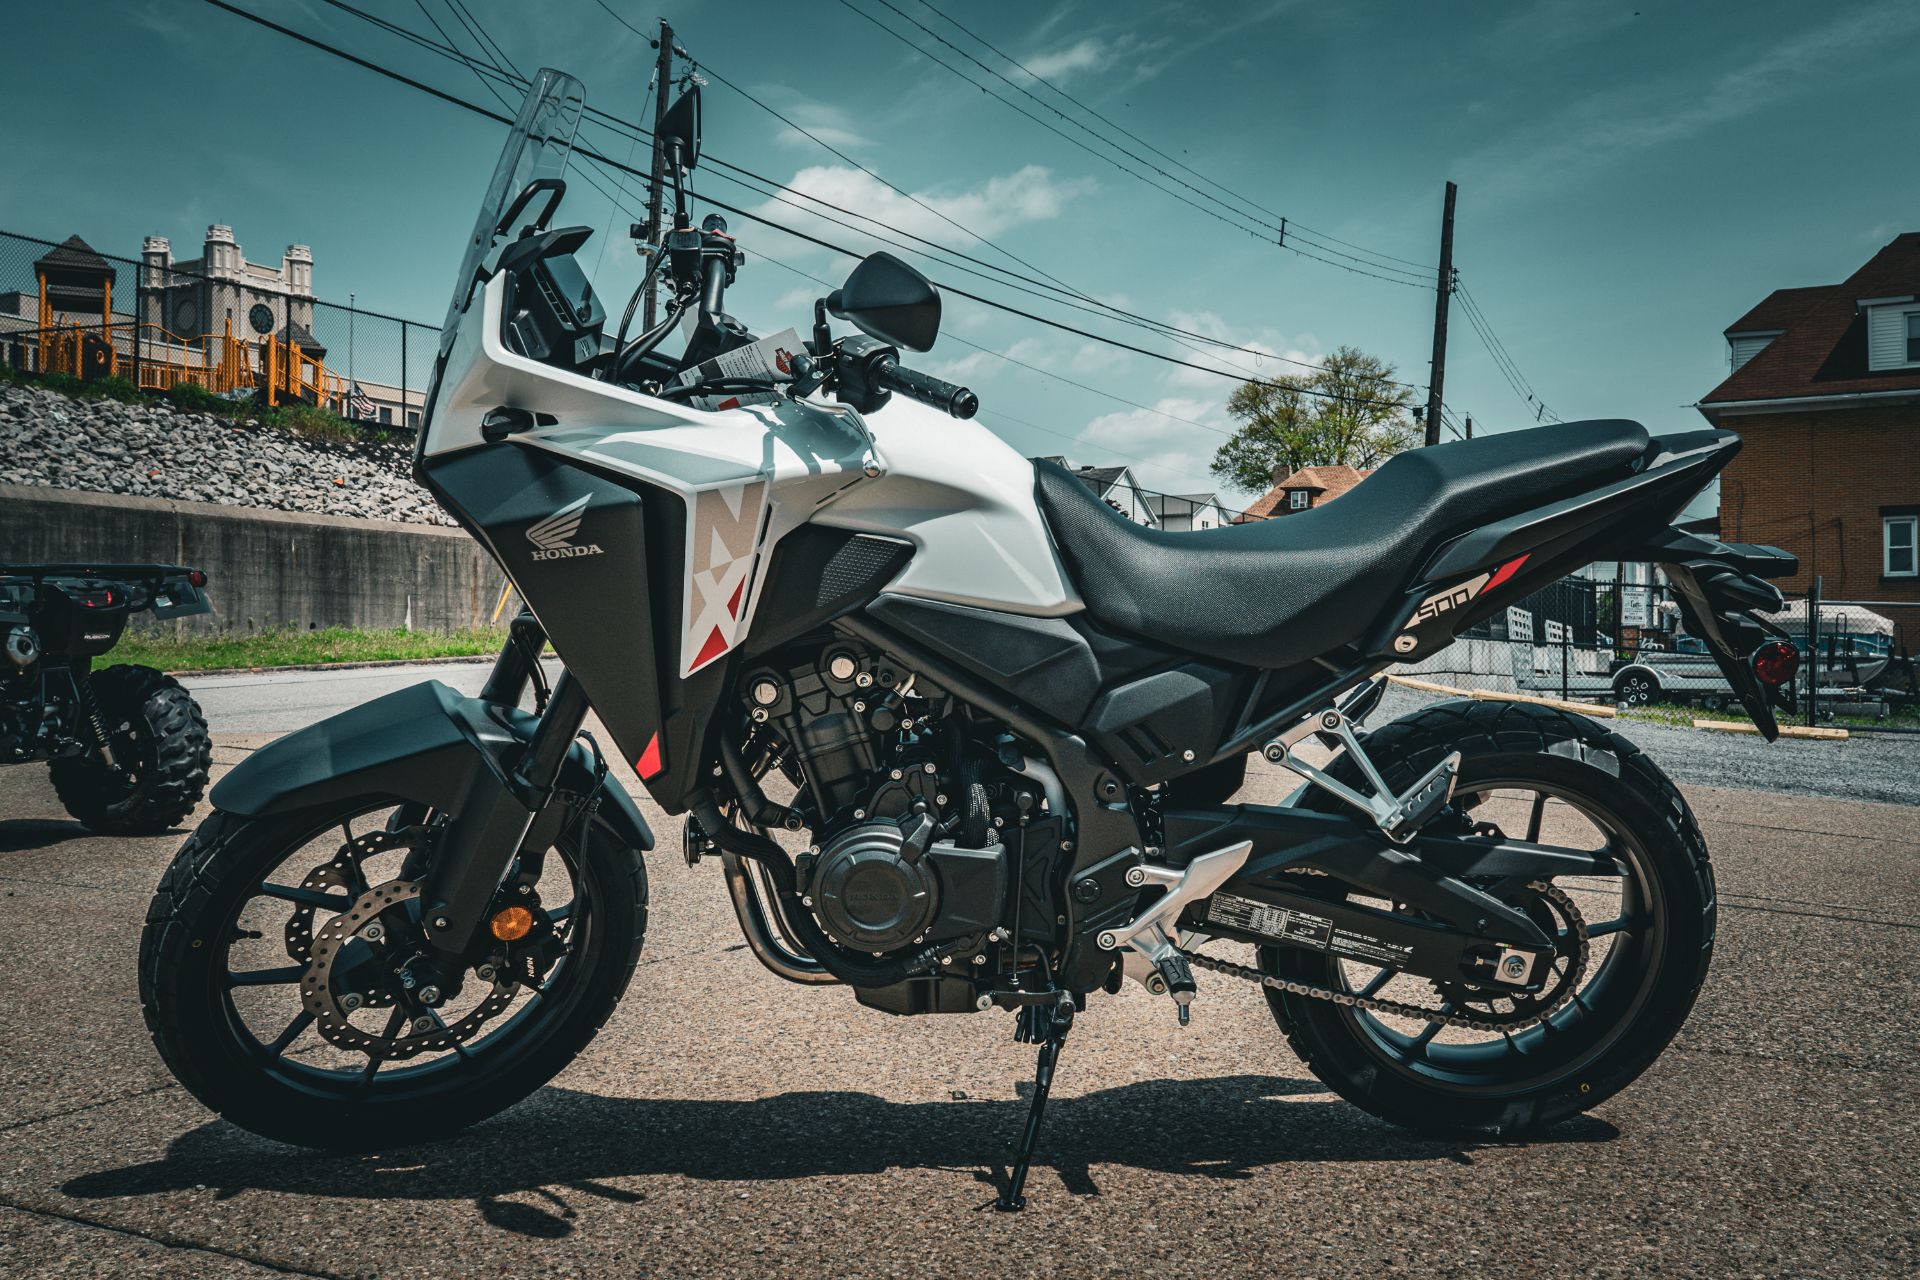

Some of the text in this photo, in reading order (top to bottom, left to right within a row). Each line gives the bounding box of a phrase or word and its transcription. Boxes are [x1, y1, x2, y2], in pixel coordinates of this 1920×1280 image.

[531, 544, 604, 560] HONDA
[687, 481, 766, 674] NX
[1416, 587, 1471, 617] 500
